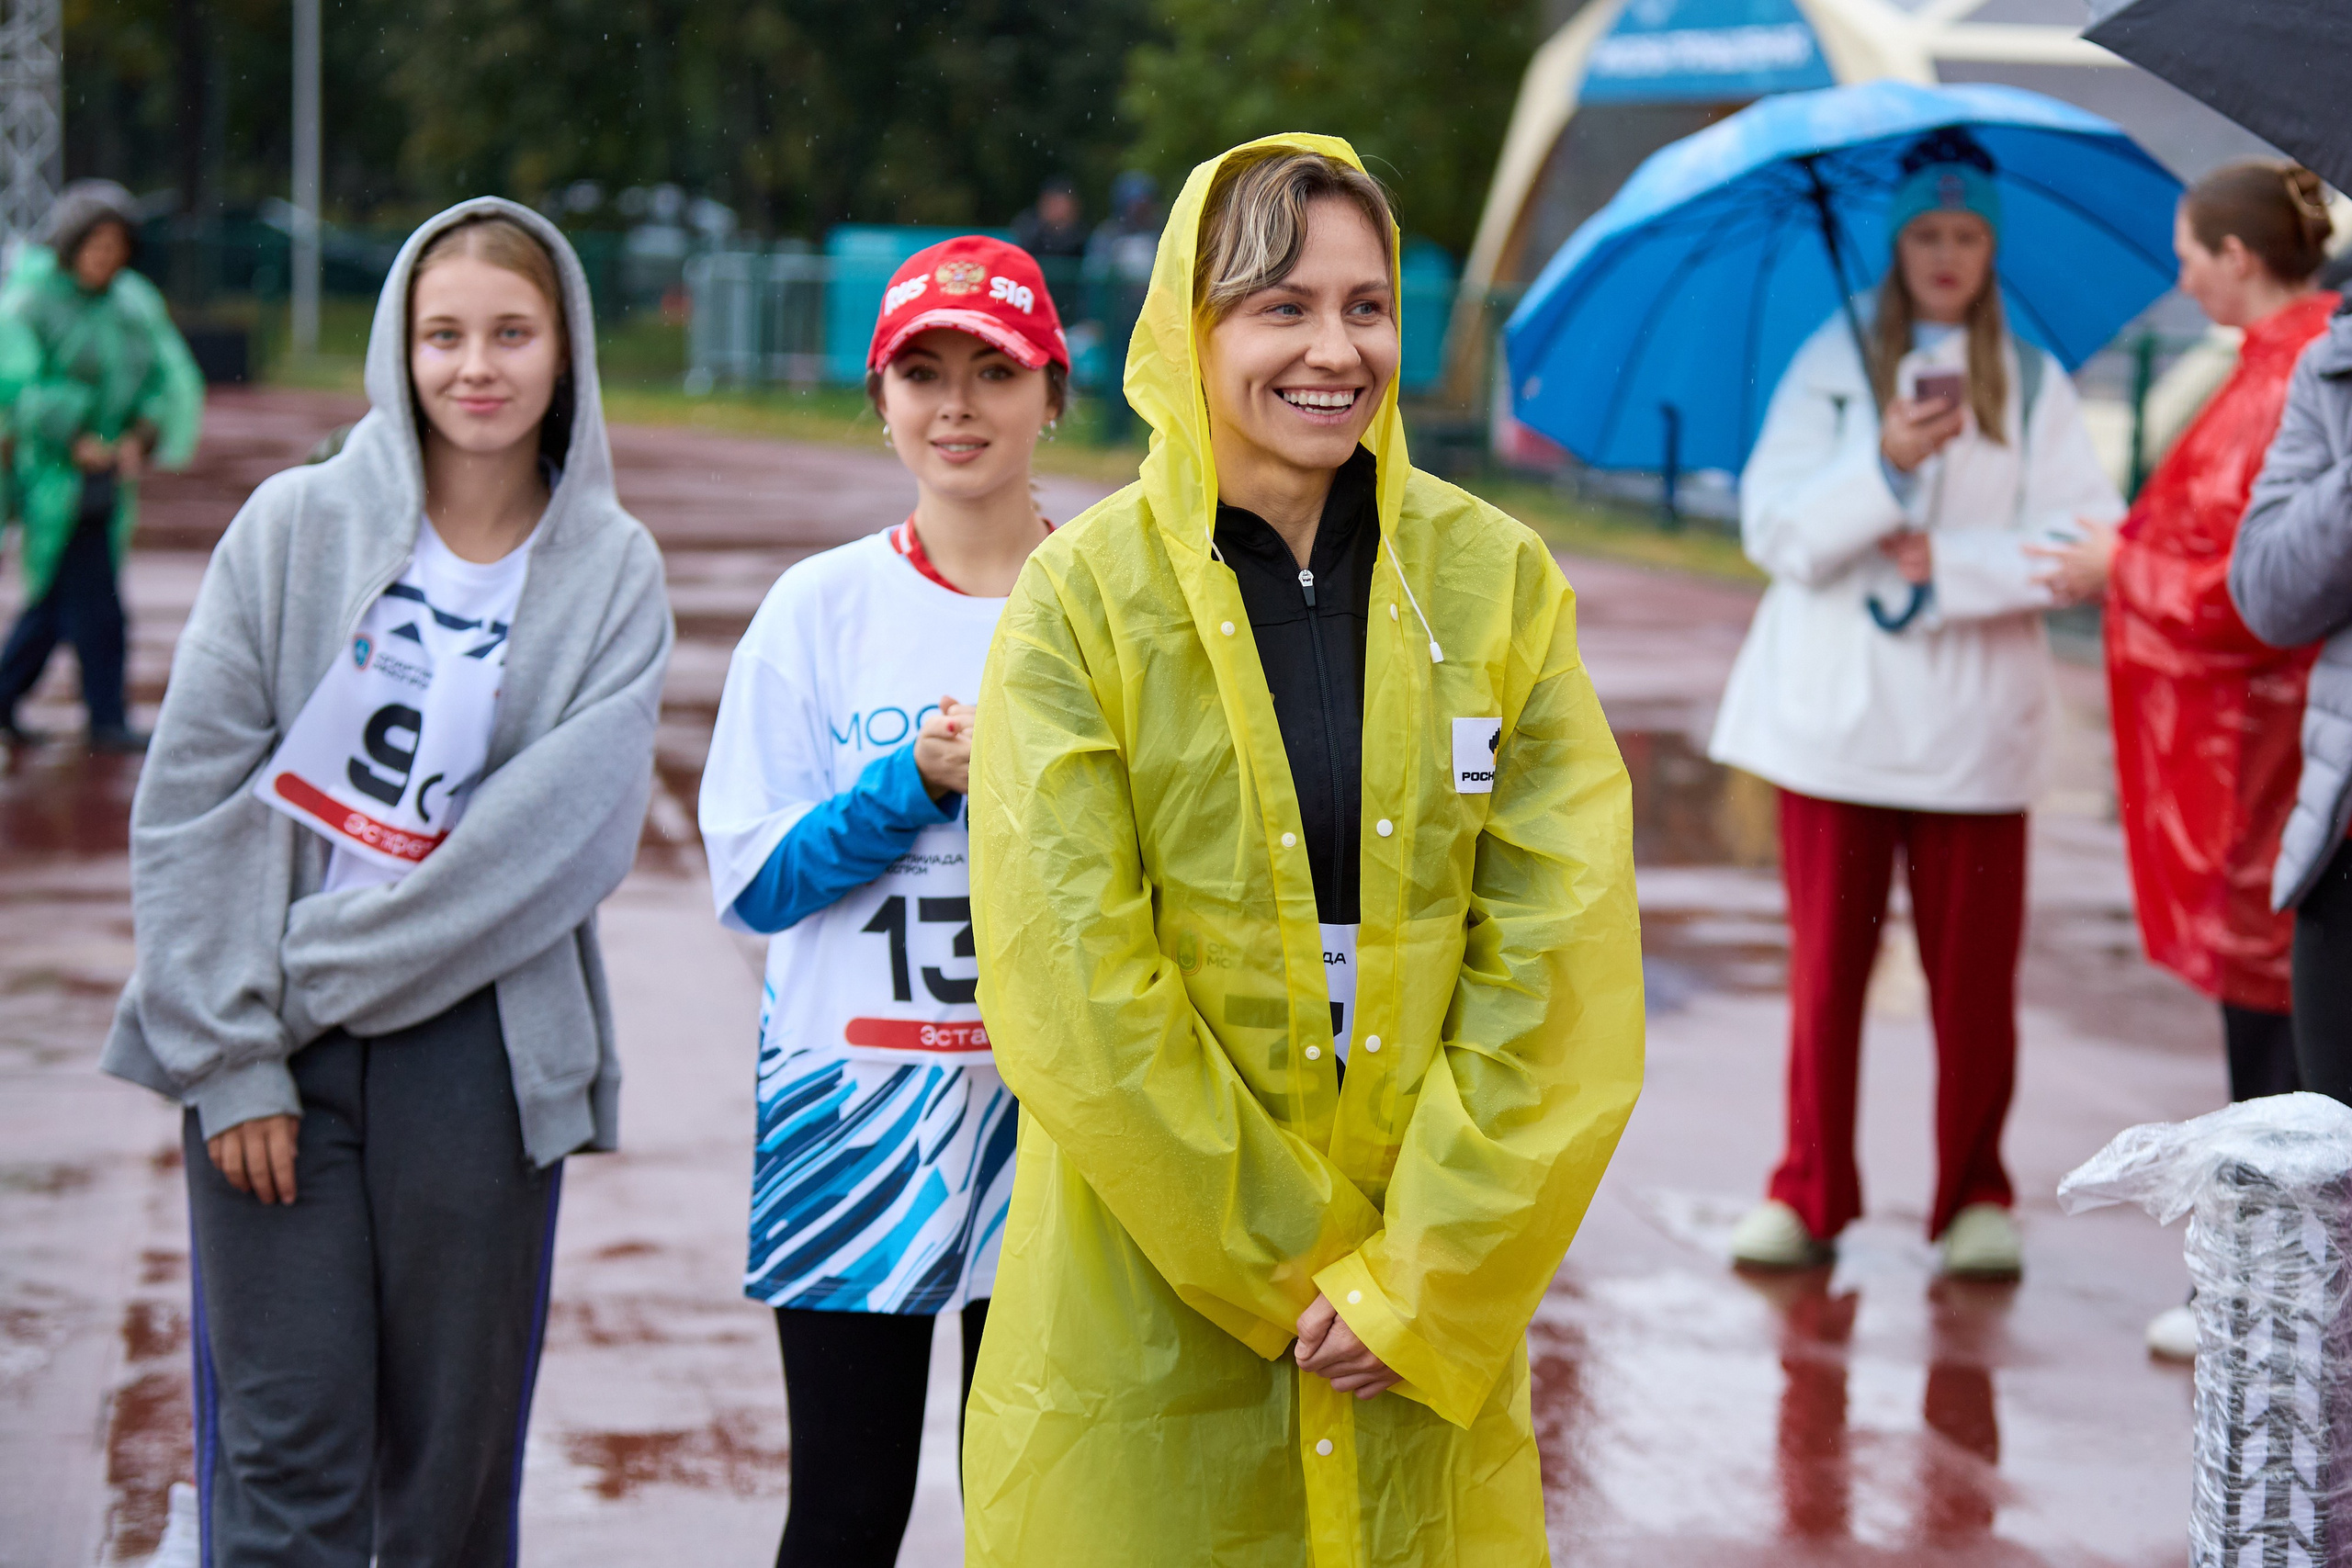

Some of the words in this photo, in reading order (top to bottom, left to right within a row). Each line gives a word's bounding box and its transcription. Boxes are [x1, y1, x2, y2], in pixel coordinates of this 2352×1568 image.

[883, 273, 931, 316] RUS
[989, 276, 1035, 315] SIA
[861, 895, 978, 1004] 13
[920, 1024, 989, 1046] Эста
